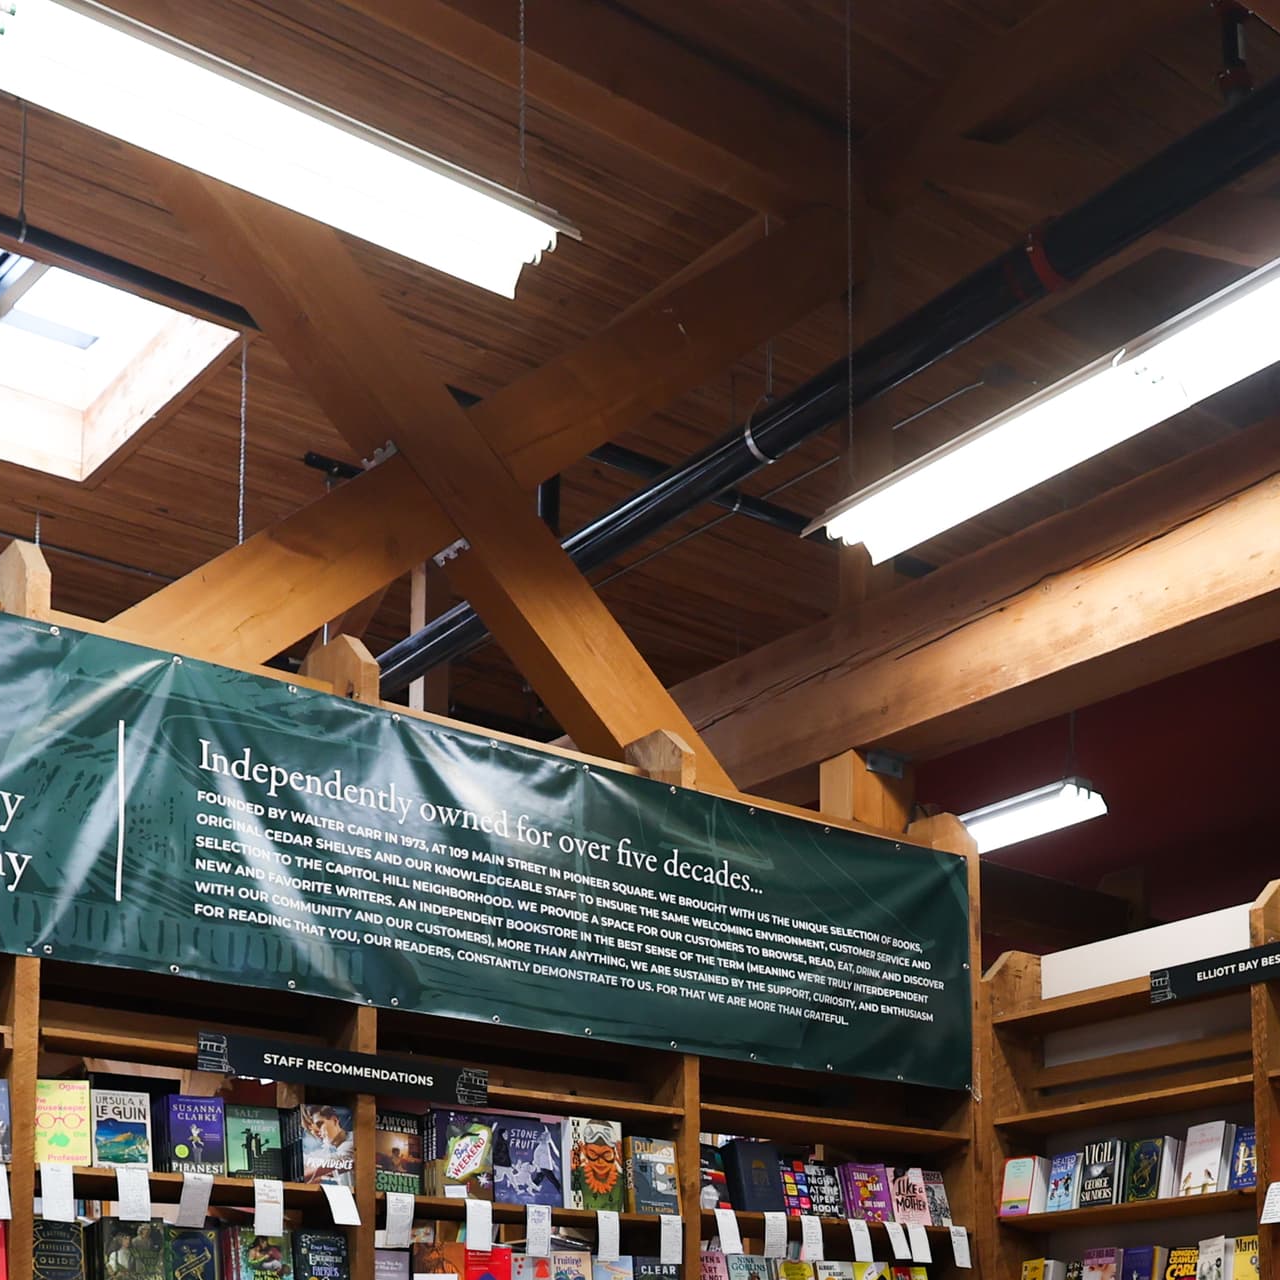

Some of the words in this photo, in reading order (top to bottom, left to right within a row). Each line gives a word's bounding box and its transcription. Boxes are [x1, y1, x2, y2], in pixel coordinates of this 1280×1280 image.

[197, 739, 413, 824] Independently
[419, 800, 510, 838] owned
[516, 814, 554, 849] for
[558, 835, 611, 862] over
[617, 838, 658, 873] five
[663, 850, 764, 895] decades...
[197, 790, 265, 816] FOUNDED
[268, 807, 288, 820] BY
[290, 810, 344, 832] WALTER
[347, 824, 382, 840] CARR
[384, 831, 398, 844] IN
[400, 835, 429, 852] 1973,
[431, 843, 447, 854] AT
[448, 846, 469, 859] 109
[471, 850, 504, 865] MAIN
[506, 857, 548, 875] STREET
[549, 867, 561, 879] IN
[563, 870, 610, 889] PIONEER
[612, 881, 657, 900] SQUARE.
[658, 891, 676, 904] WE
[678, 896, 728, 914] BROUGHT
[729, 906, 755, 920] WITH
[756, 912, 770, 923] US
[771, 914, 790, 927] THE
[791, 919, 829, 934] UNIQUE
[829, 926, 880, 942] SELECTION
[880, 935, 892, 944] OF
[892, 938, 922, 953] BOOKS,
[1196, 963, 1236, 982] ELLIOTT
[1238, 959, 1259, 973] BAY
[263, 1052, 304, 1071] STAFF
[307, 1058, 434, 1088] RECOMMENDATIONS
[96, 1105, 108, 1118] LE
[112, 1105, 147, 1121] GUIN
[172, 1103, 222, 1114] SUSANNA
[177, 1112, 217, 1122] CLARKE
[510, 1128, 538, 1140] STONE
[510, 1138, 537, 1149] FRUIT
[451, 1137, 485, 1178] WEEKEND
[1084, 1141, 1115, 1166] VIGIL
[1084, 1177, 1109, 1190] GEORGE
[1081, 1188, 1112, 1202] SAUNDERS
[640, 1265, 676, 1276] CLEAR
